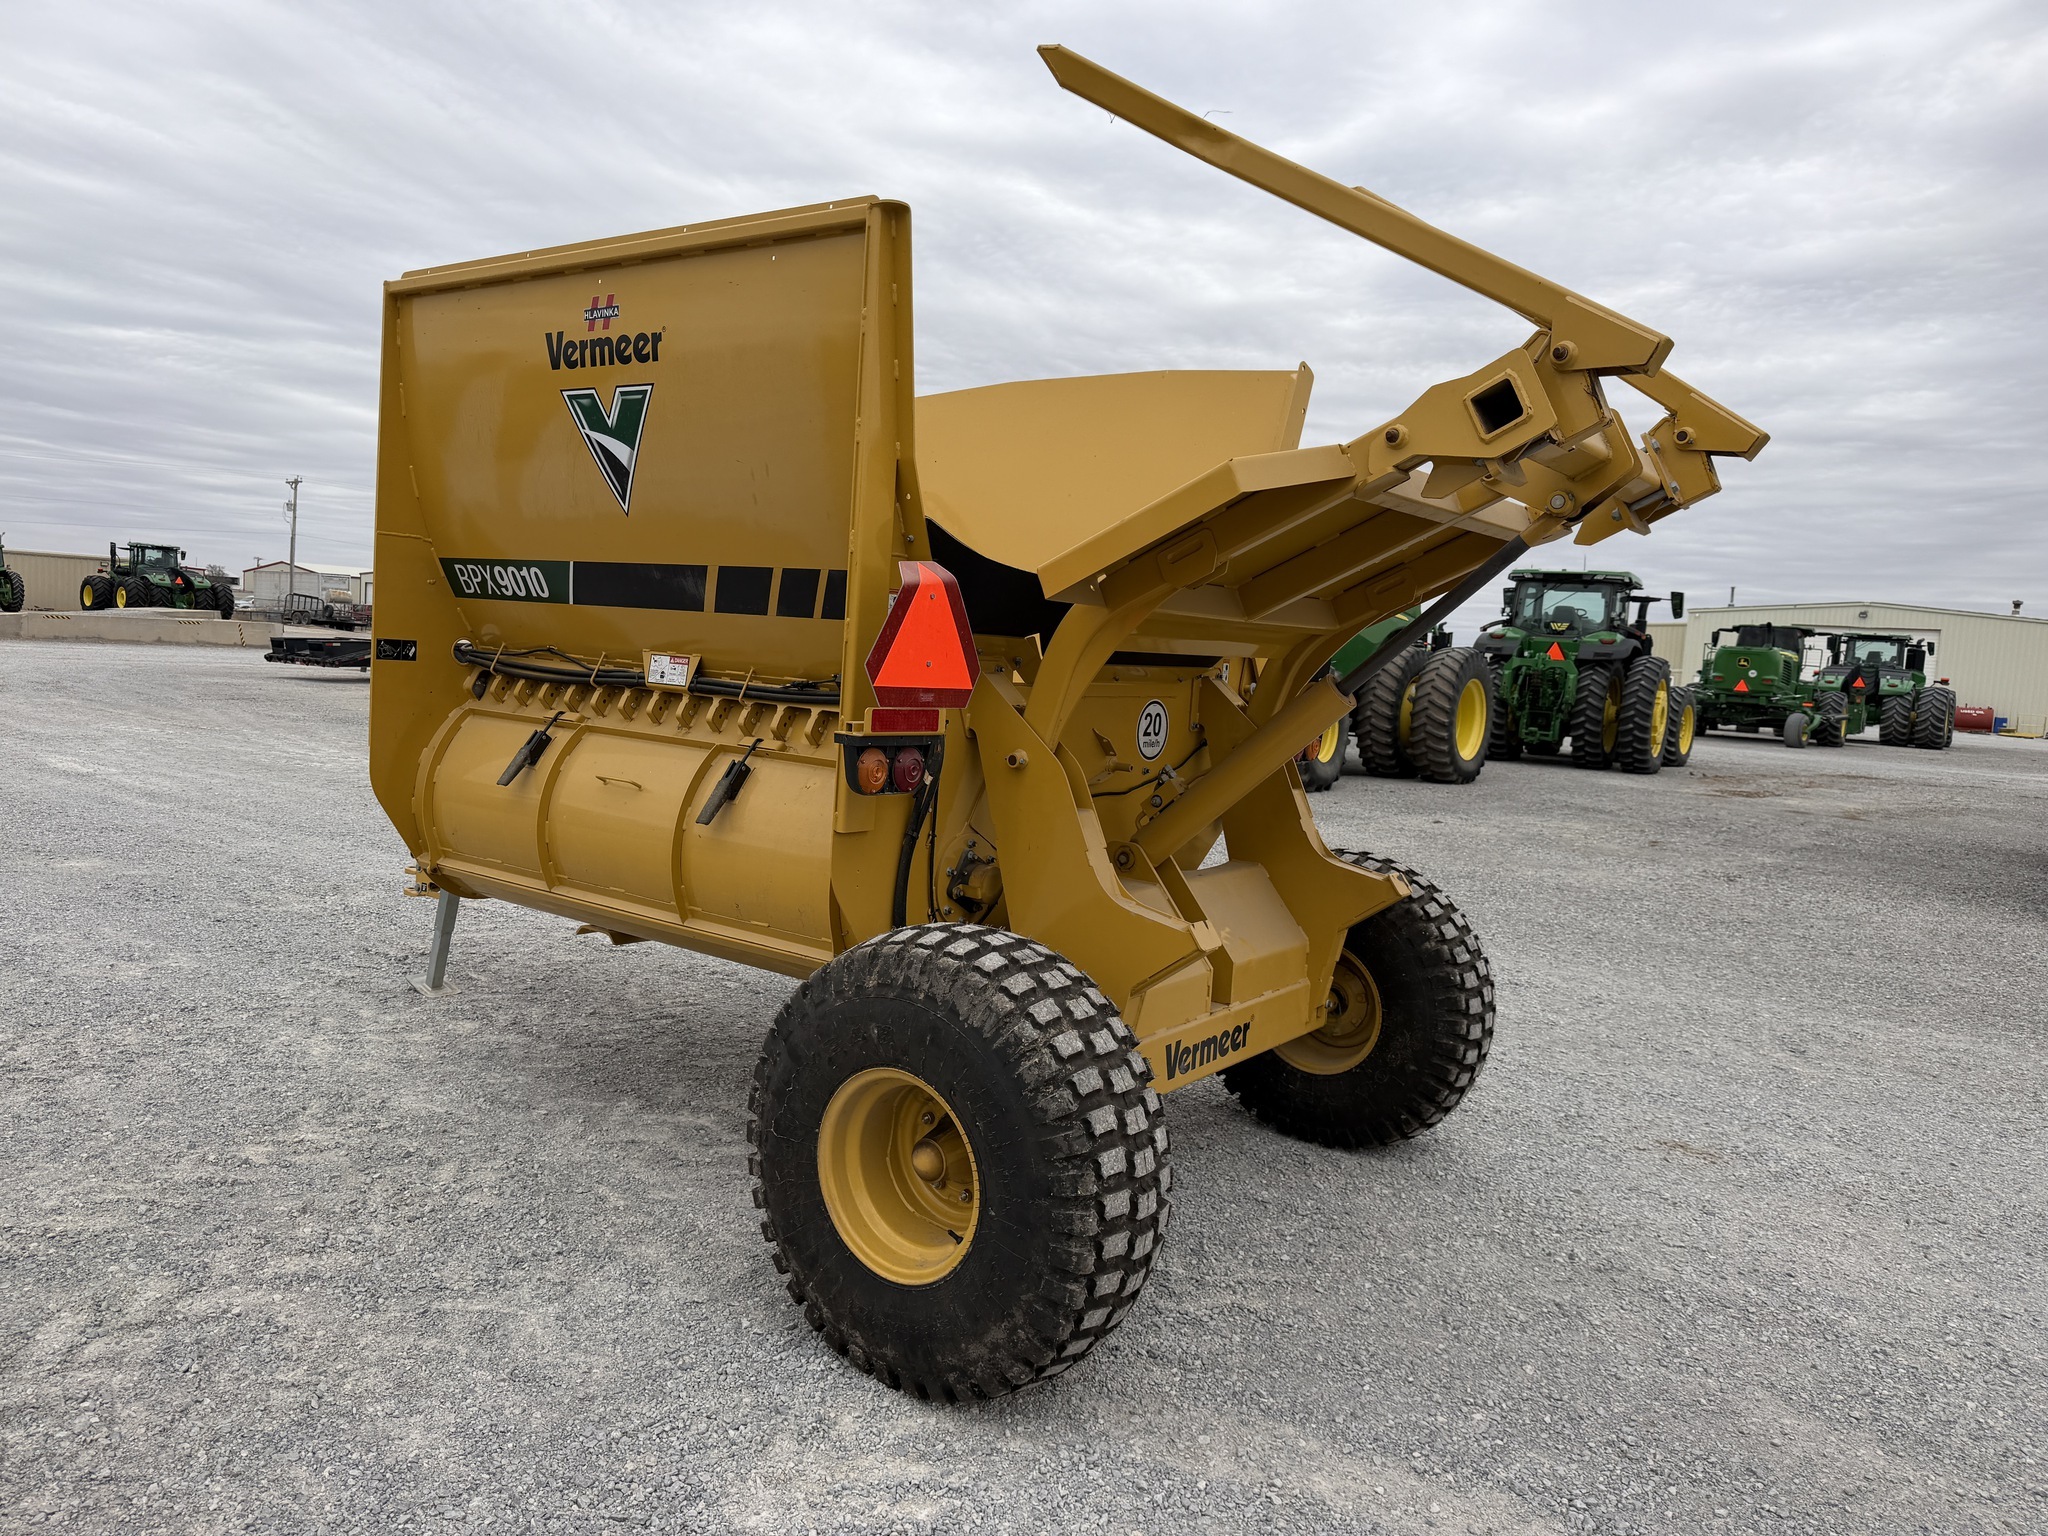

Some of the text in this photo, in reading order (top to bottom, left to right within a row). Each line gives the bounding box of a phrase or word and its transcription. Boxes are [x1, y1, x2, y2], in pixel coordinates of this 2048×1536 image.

[584, 307, 619, 320] HLAVINKA
[545, 331, 662, 371] Vermeer
[454, 563, 549, 599] BPX9010
[1142, 712, 1162, 737] 20
[1165, 1021, 1250, 1081] Vermeer
